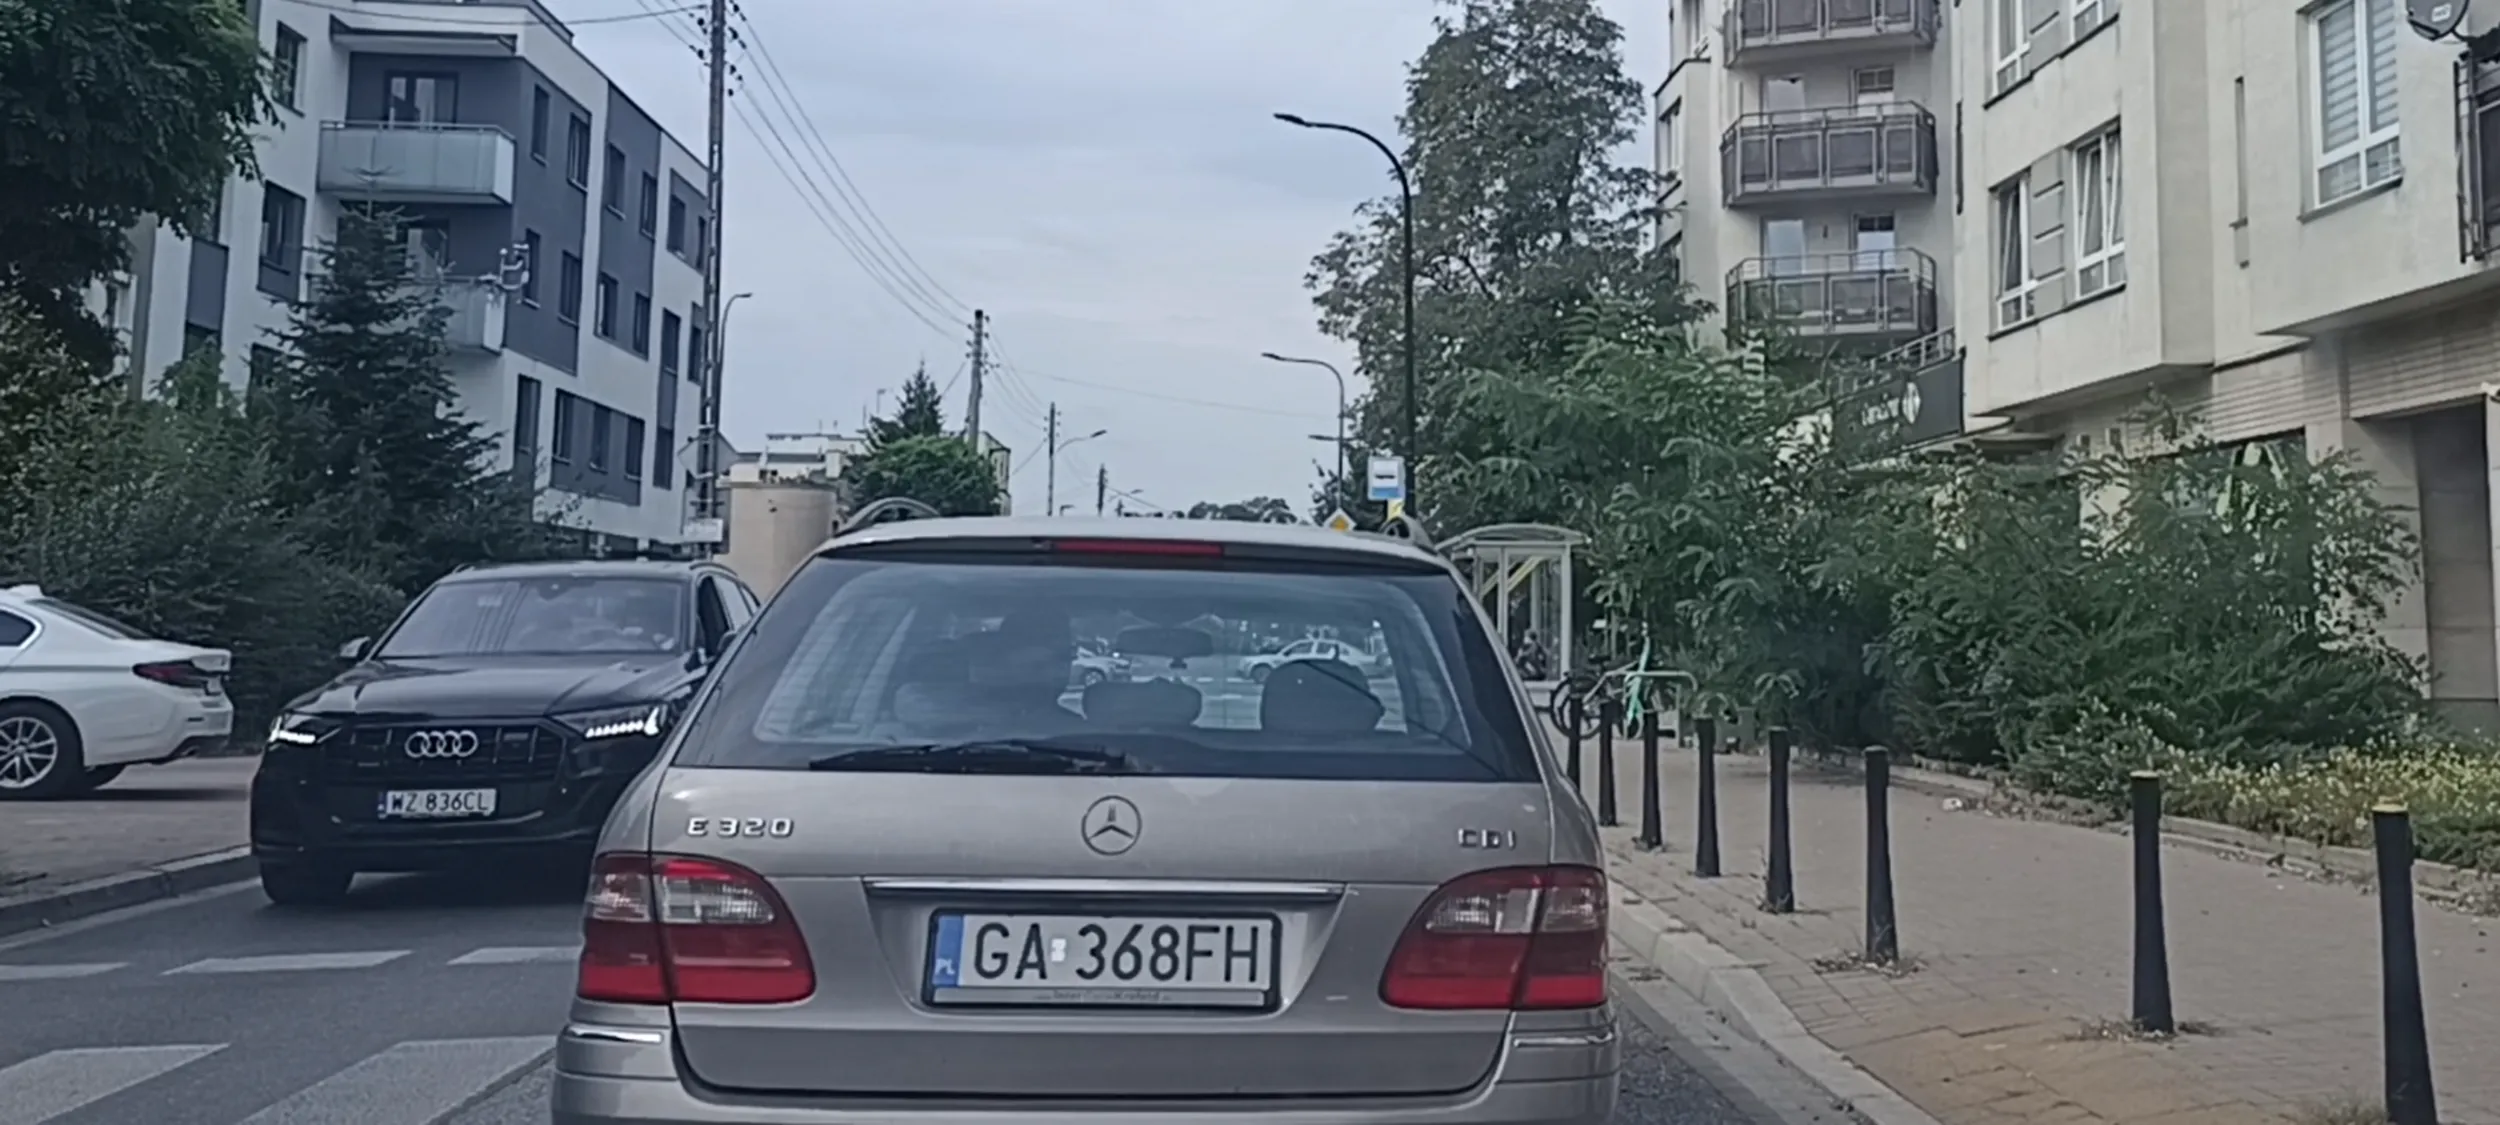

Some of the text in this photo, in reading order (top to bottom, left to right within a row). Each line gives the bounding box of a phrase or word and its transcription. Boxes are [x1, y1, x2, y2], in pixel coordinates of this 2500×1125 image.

[391, 794, 417, 813] WZ
[426, 792, 489, 812] 836CL
[687, 817, 795, 838] E 320
[1458, 829, 1516, 850] CDI
[974, 922, 1259, 983] GA 368FH
[935, 958, 955, 975] PL
